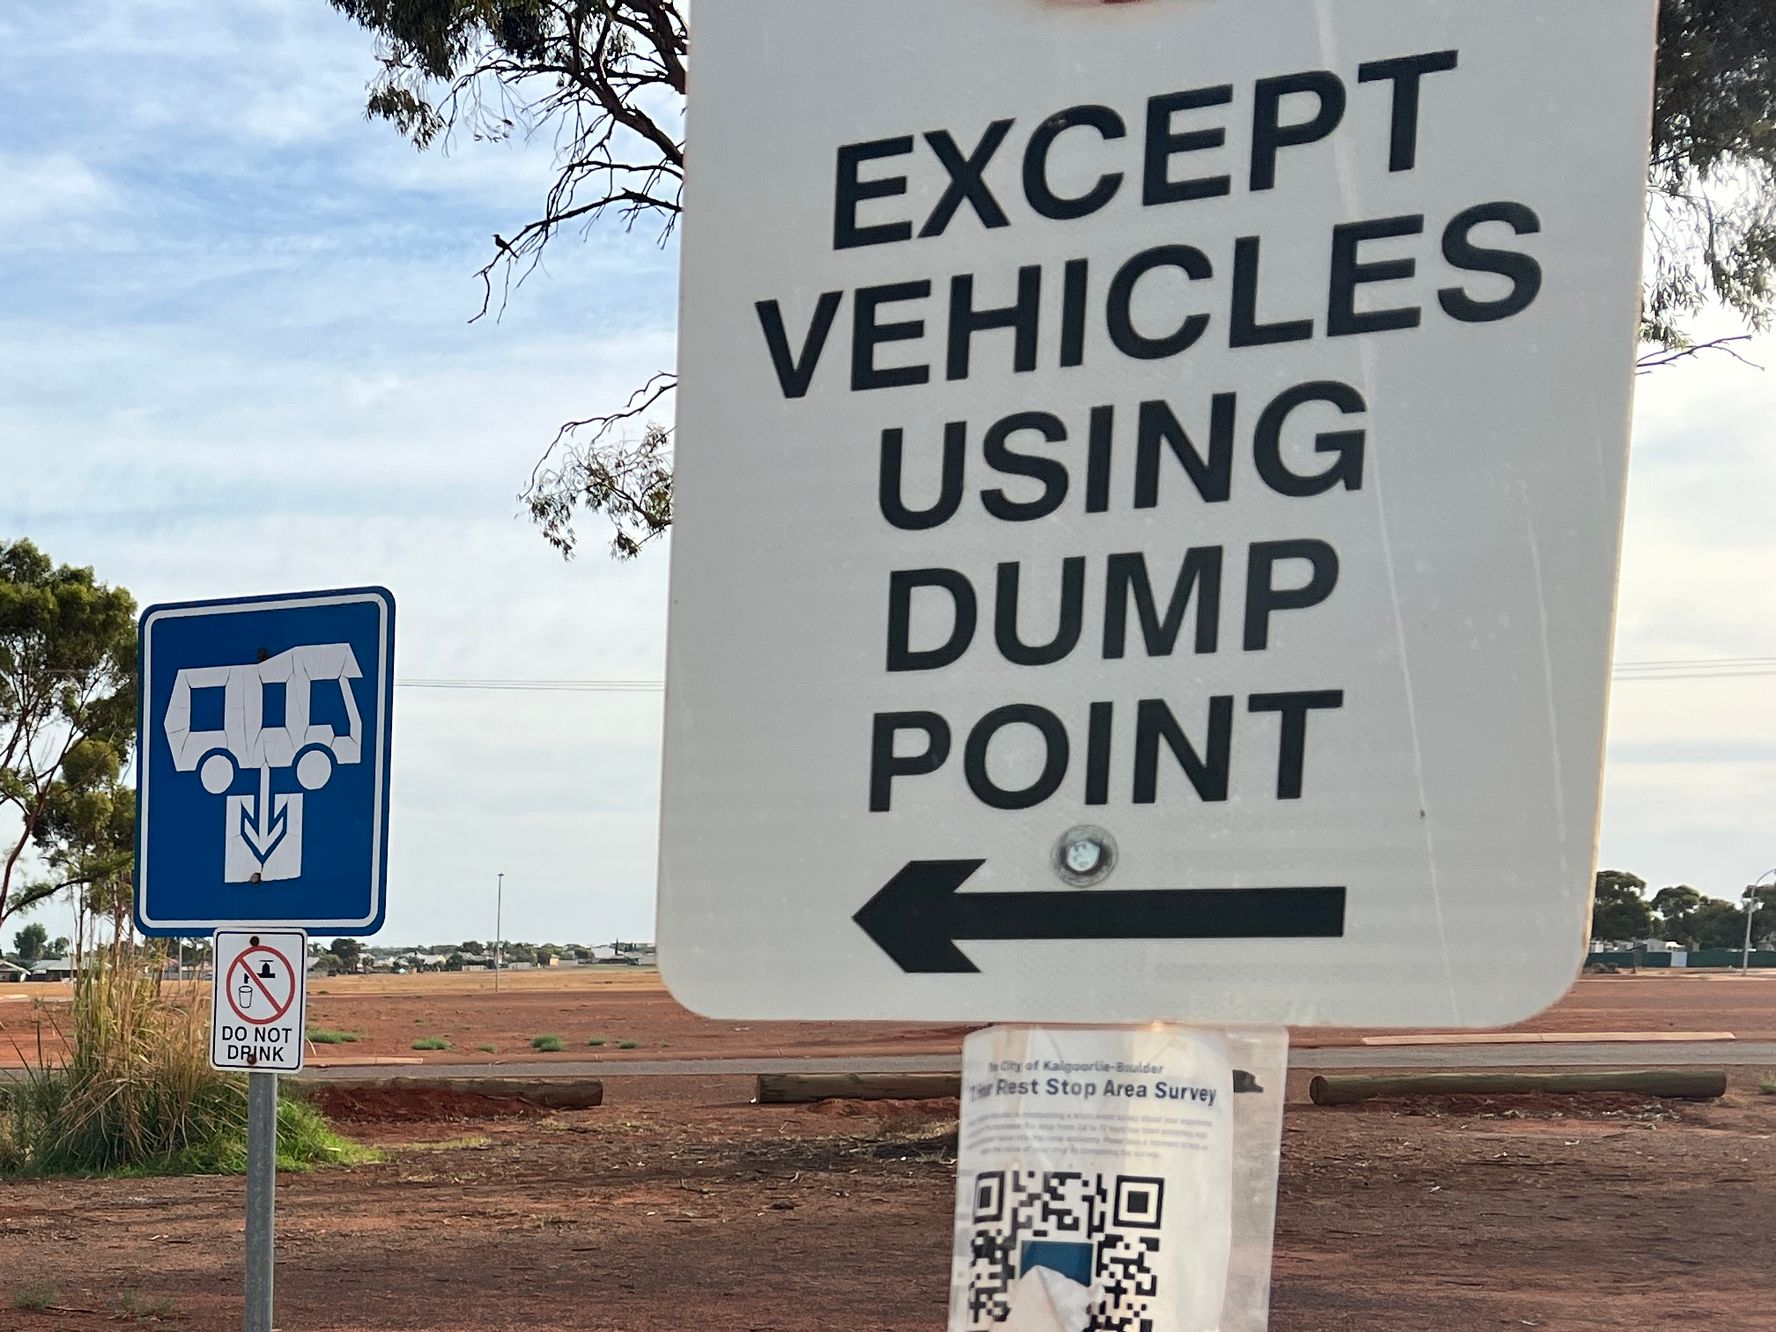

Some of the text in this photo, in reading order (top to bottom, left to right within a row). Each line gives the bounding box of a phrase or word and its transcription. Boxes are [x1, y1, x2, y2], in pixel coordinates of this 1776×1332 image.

[832, 49, 1459, 251] EXCEPT
[754, 201, 1542, 399] VEHICLES
[878, 380, 1367, 531] USING
[885, 538, 1340, 673] DUMP
[869, 689, 1344, 813] POINT
[222, 1026, 293, 1044] DO NOT
[227, 1044, 285, 1062] DRINK
[996, 1078, 1039, 1096] Rest
[1046, 1077, 1097, 1100] Stop
[1103, 1079, 1147, 1098] Area
[1154, 1081, 1217, 1107] Survey
[1025, 1060, 1039, 1072] of
